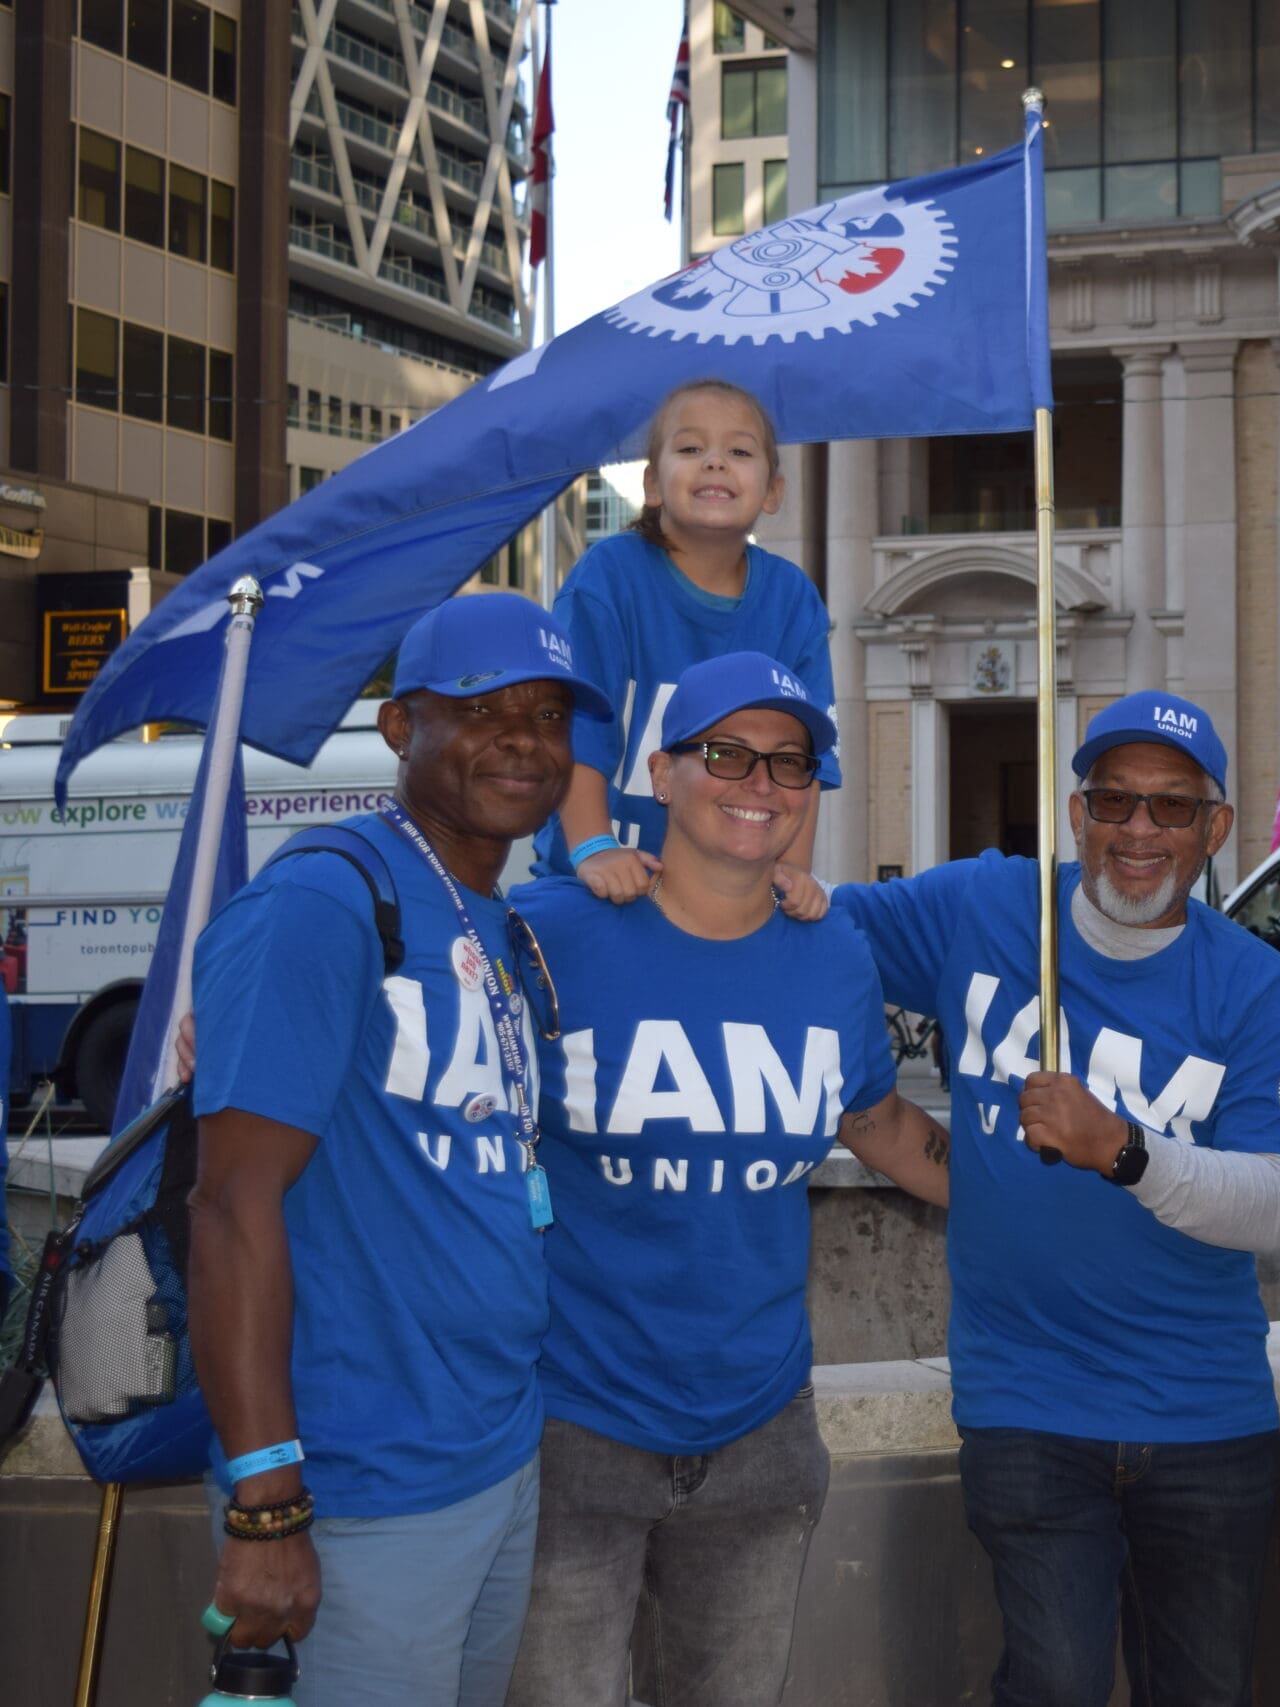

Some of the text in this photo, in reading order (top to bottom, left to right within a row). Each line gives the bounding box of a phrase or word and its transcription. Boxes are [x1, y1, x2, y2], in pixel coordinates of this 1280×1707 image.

[540, 628, 573, 664] IAM
[771, 669, 807, 700] IAM
[1153, 706, 1198, 733] IAM
[1157, 722, 1193, 739] UNION
[50, 799, 147, 828] explore
[400, 820, 465, 911] JOIN FOR YOUR FUTURE
[57, 909, 117, 926] FIND
[959, 971, 1227, 1144] IAM
[562, 1019, 845, 1137] IAM
[601, 1154, 814, 1193] UNION
[27, 1272, 53, 1362] AIR CANADA
